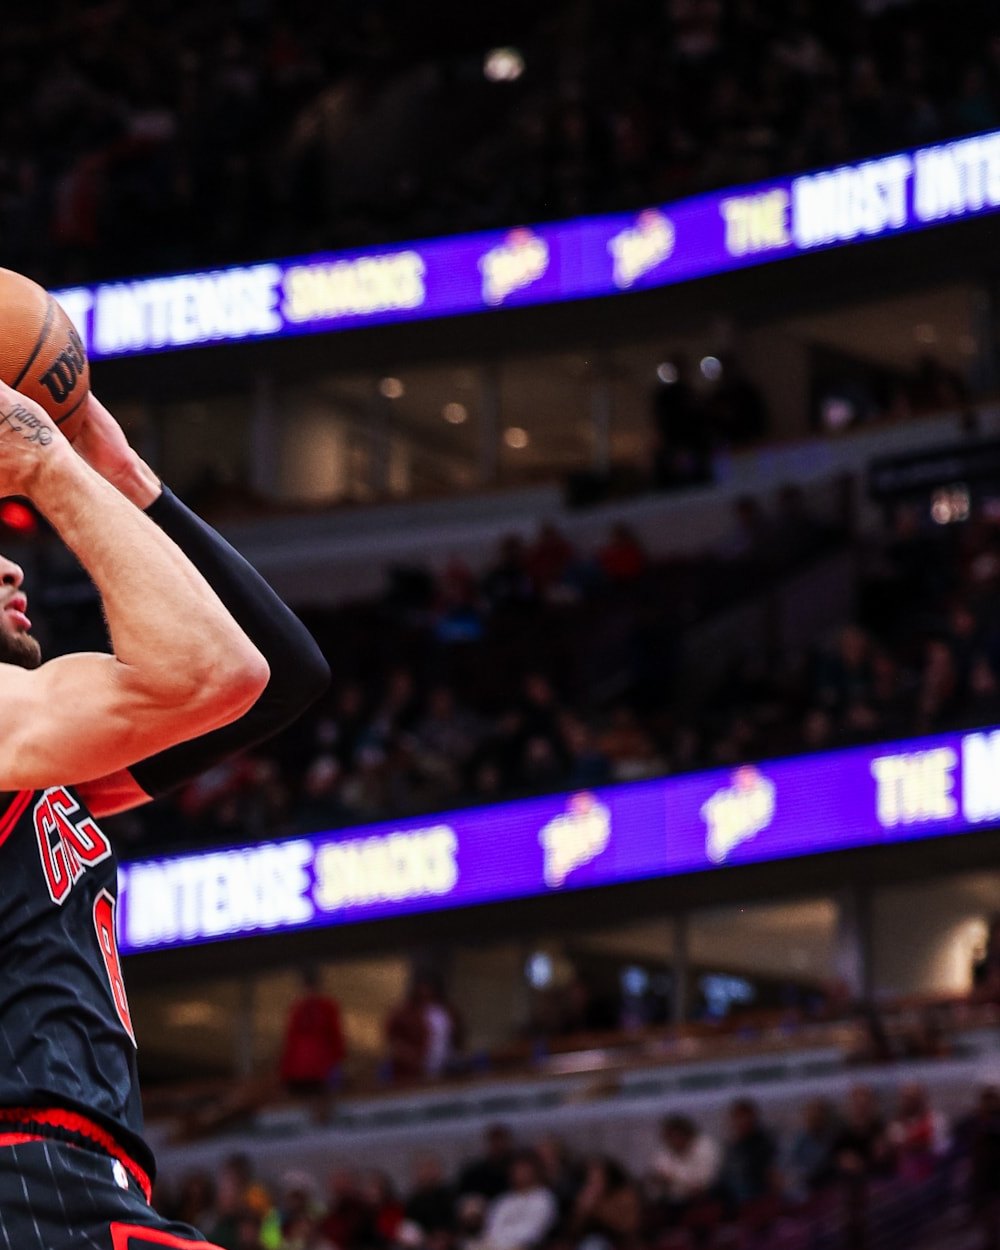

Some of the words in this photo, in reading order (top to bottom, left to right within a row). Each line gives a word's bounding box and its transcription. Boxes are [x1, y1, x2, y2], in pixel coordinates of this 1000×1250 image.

[792, 153, 913, 249] MOST
[92, 263, 283, 354] INTENSE
[38, 328, 85, 404] Wil
[126, 839, 314, 947] INTENSE
